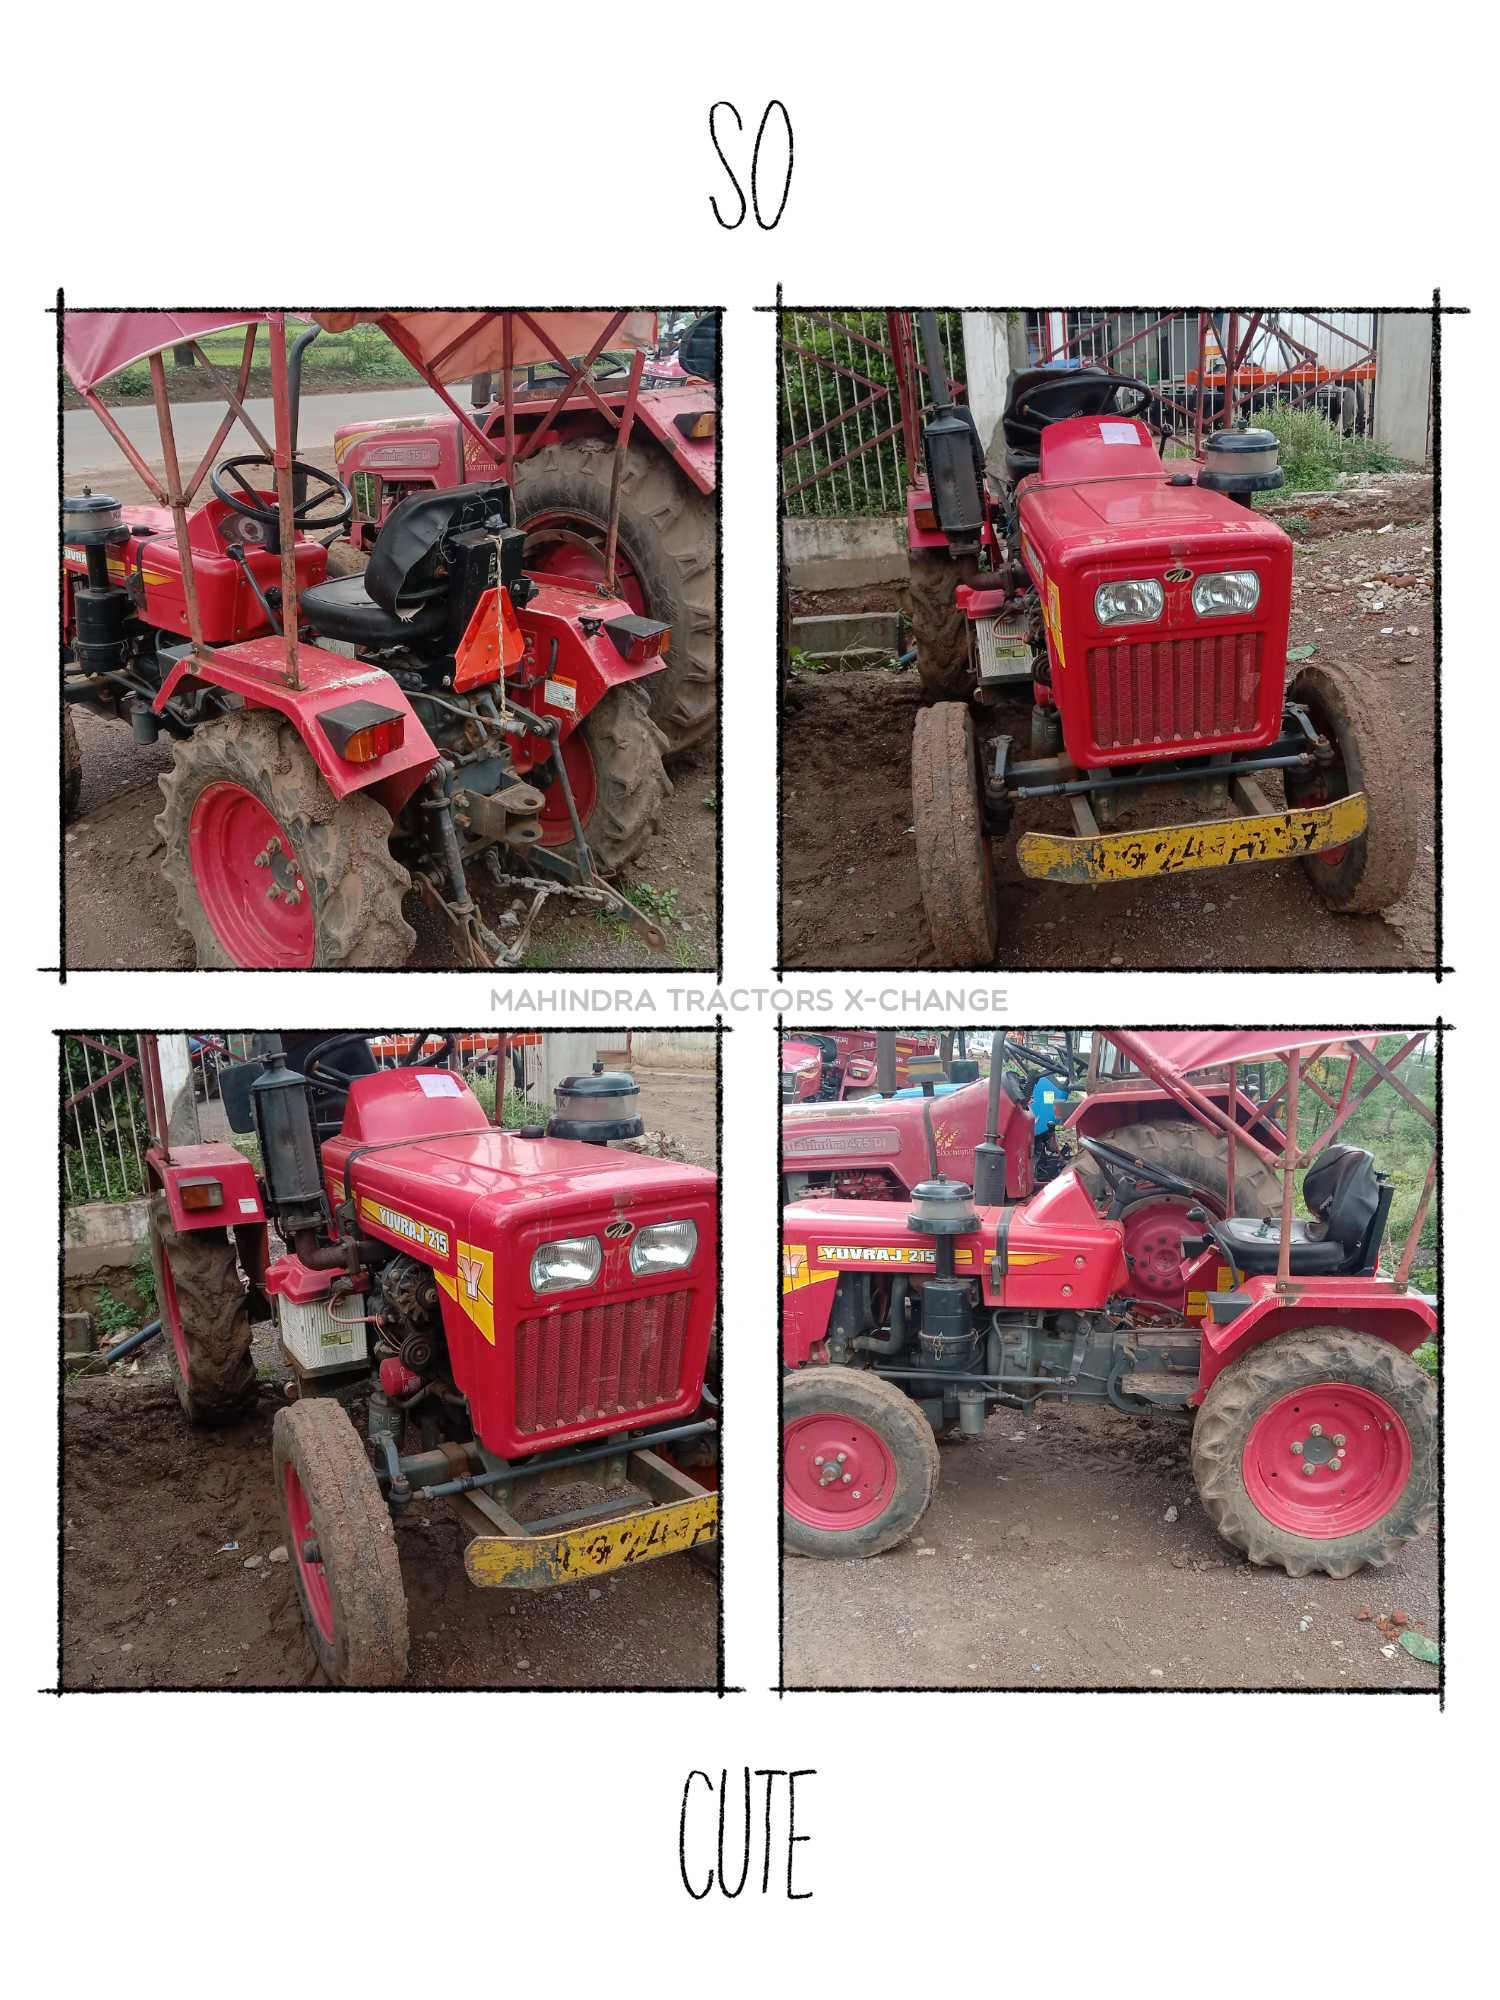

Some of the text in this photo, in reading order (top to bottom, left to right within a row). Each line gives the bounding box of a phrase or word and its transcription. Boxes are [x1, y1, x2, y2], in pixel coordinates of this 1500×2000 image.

[378, 1206, 448, 1254] YUVRAJ 215
[823, 1247, 936, 1263] YUVRAJ 215
